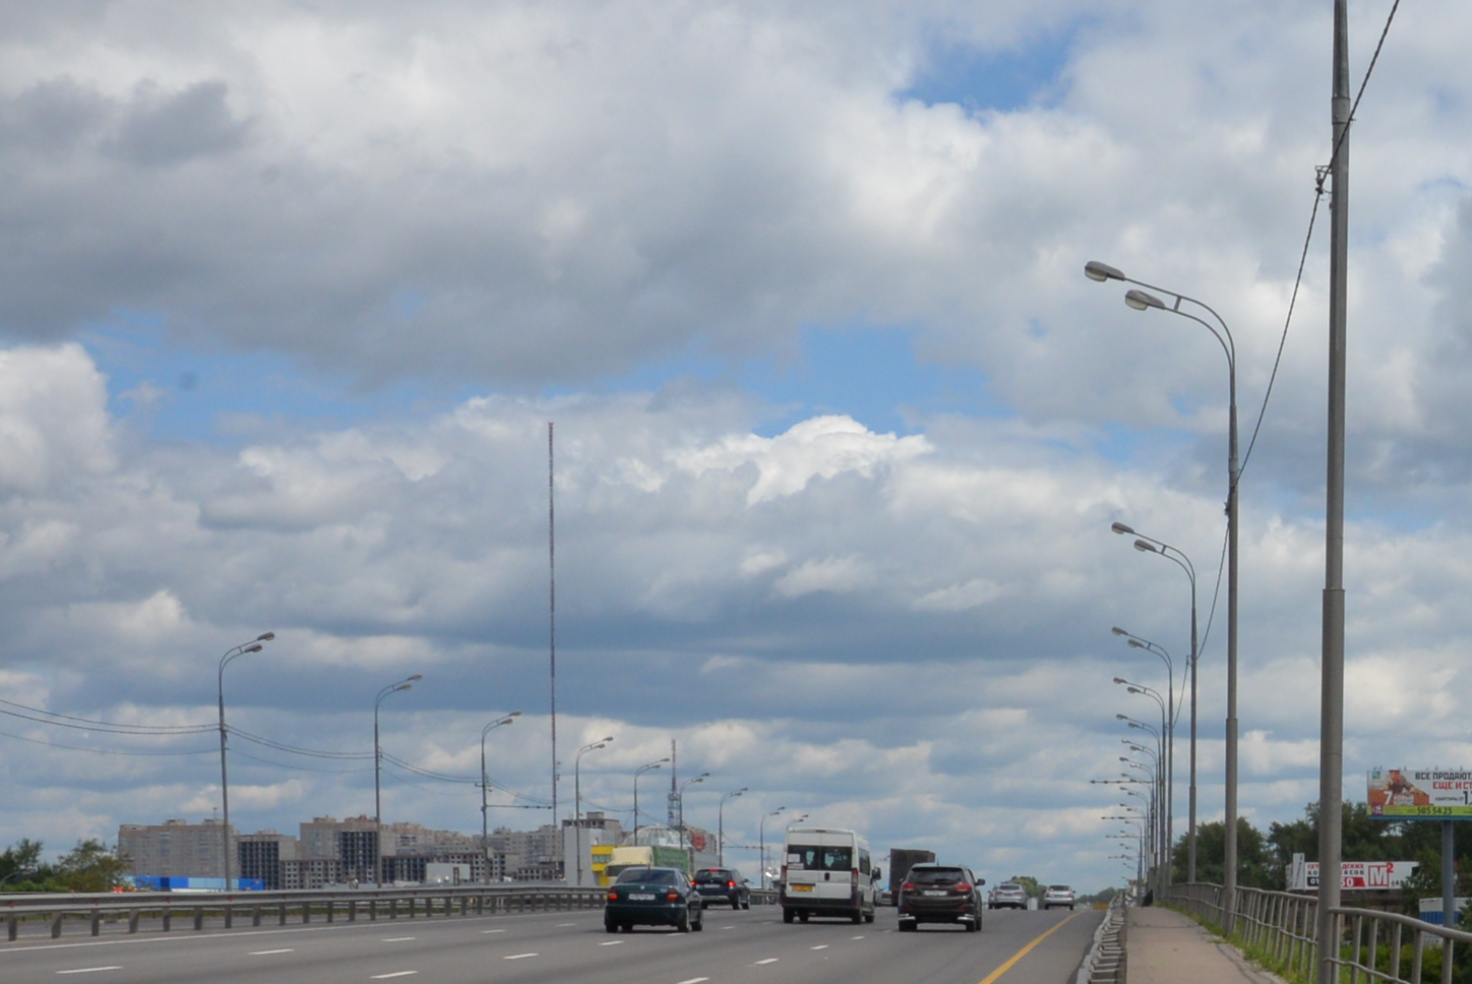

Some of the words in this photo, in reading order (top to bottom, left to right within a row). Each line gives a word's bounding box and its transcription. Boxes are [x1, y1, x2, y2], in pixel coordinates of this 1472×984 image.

[1415, 772, 1431, 780] ВСЕ
[1432, 781, 1453, 790] ЕЩЕ
[1455, 781, 1462, 789] И
[1417, 807, 1432, 815] 505
[1433, 807, 1442, 815] 54
[1442, 807, 1452, 815] 25
